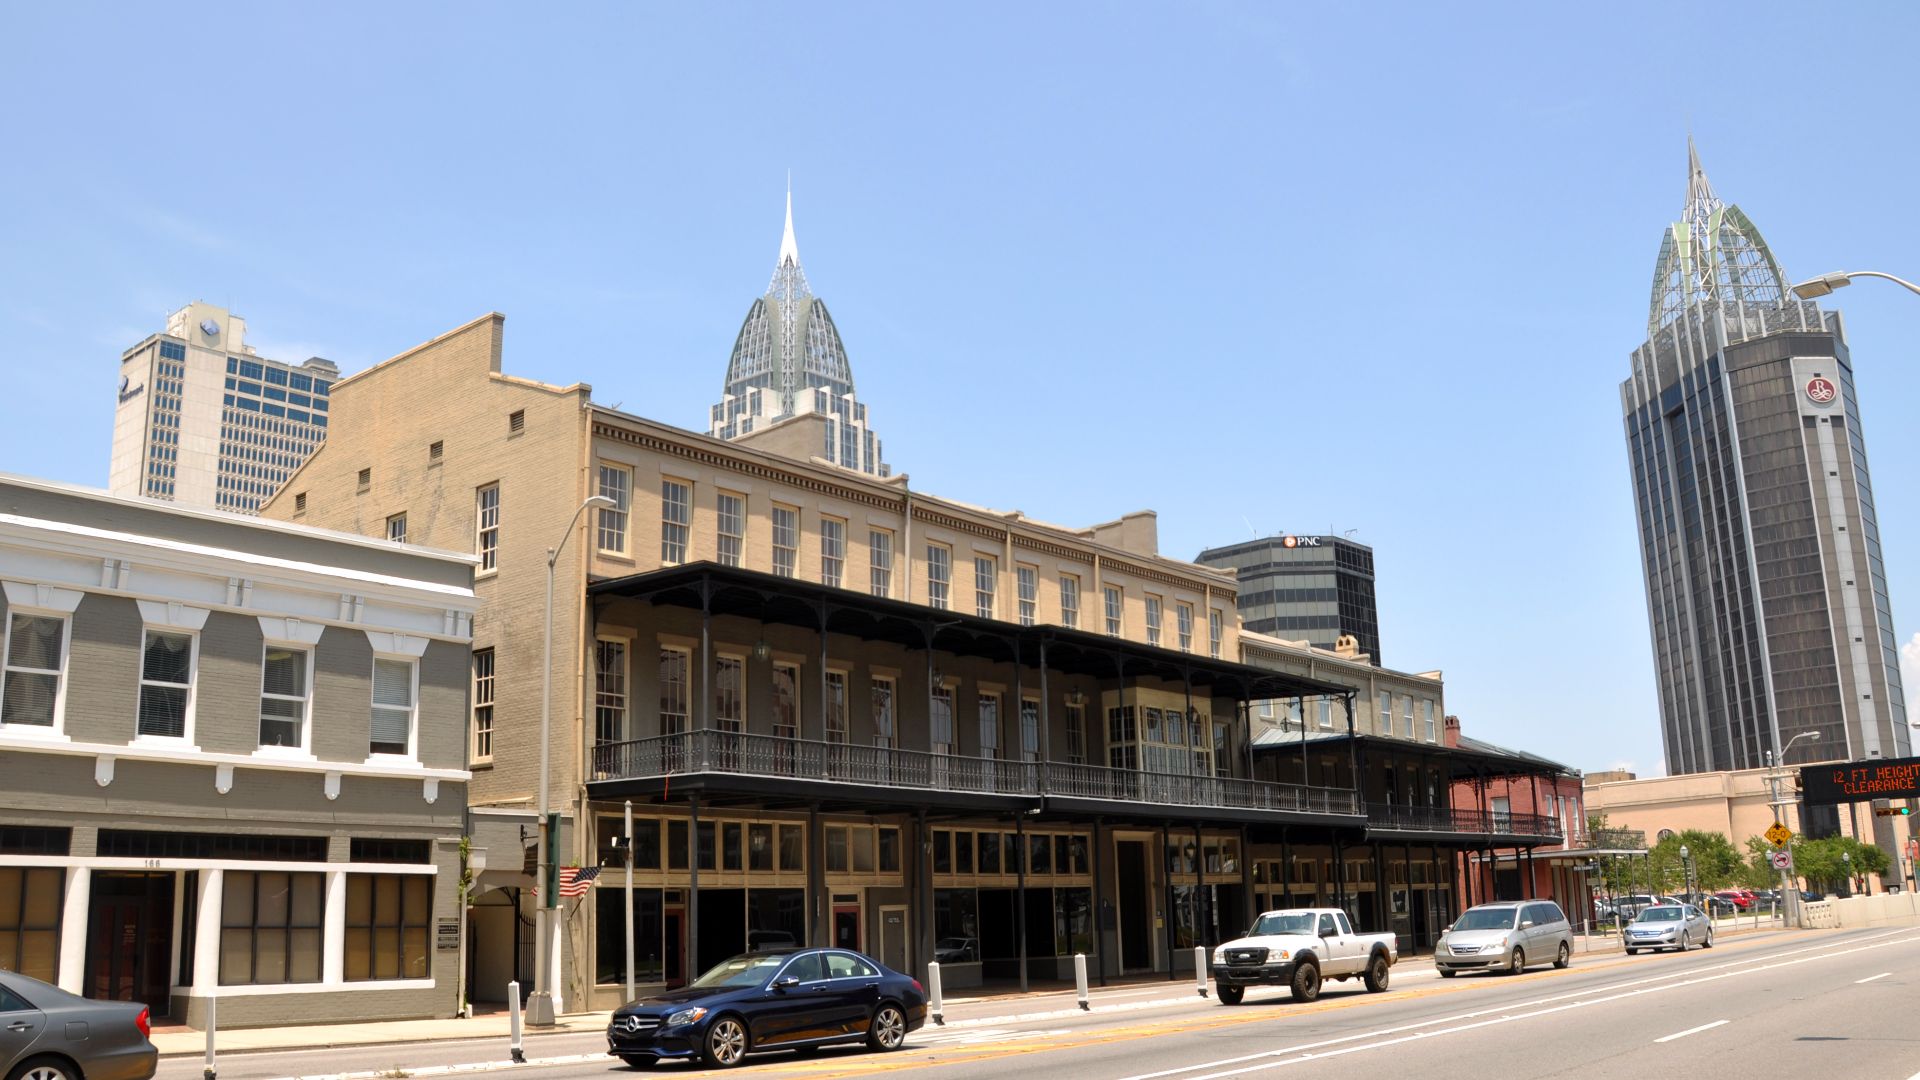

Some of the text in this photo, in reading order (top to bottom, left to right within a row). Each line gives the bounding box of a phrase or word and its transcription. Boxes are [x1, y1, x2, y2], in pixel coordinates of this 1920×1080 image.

[1297, 536, 1321, 546] PNC
[1833, 764, 1920, 784] 12 FT HEIGHT
[1843, 777, 1916, 794] CLEARANCE
[145, 859, 160, 868] 166
